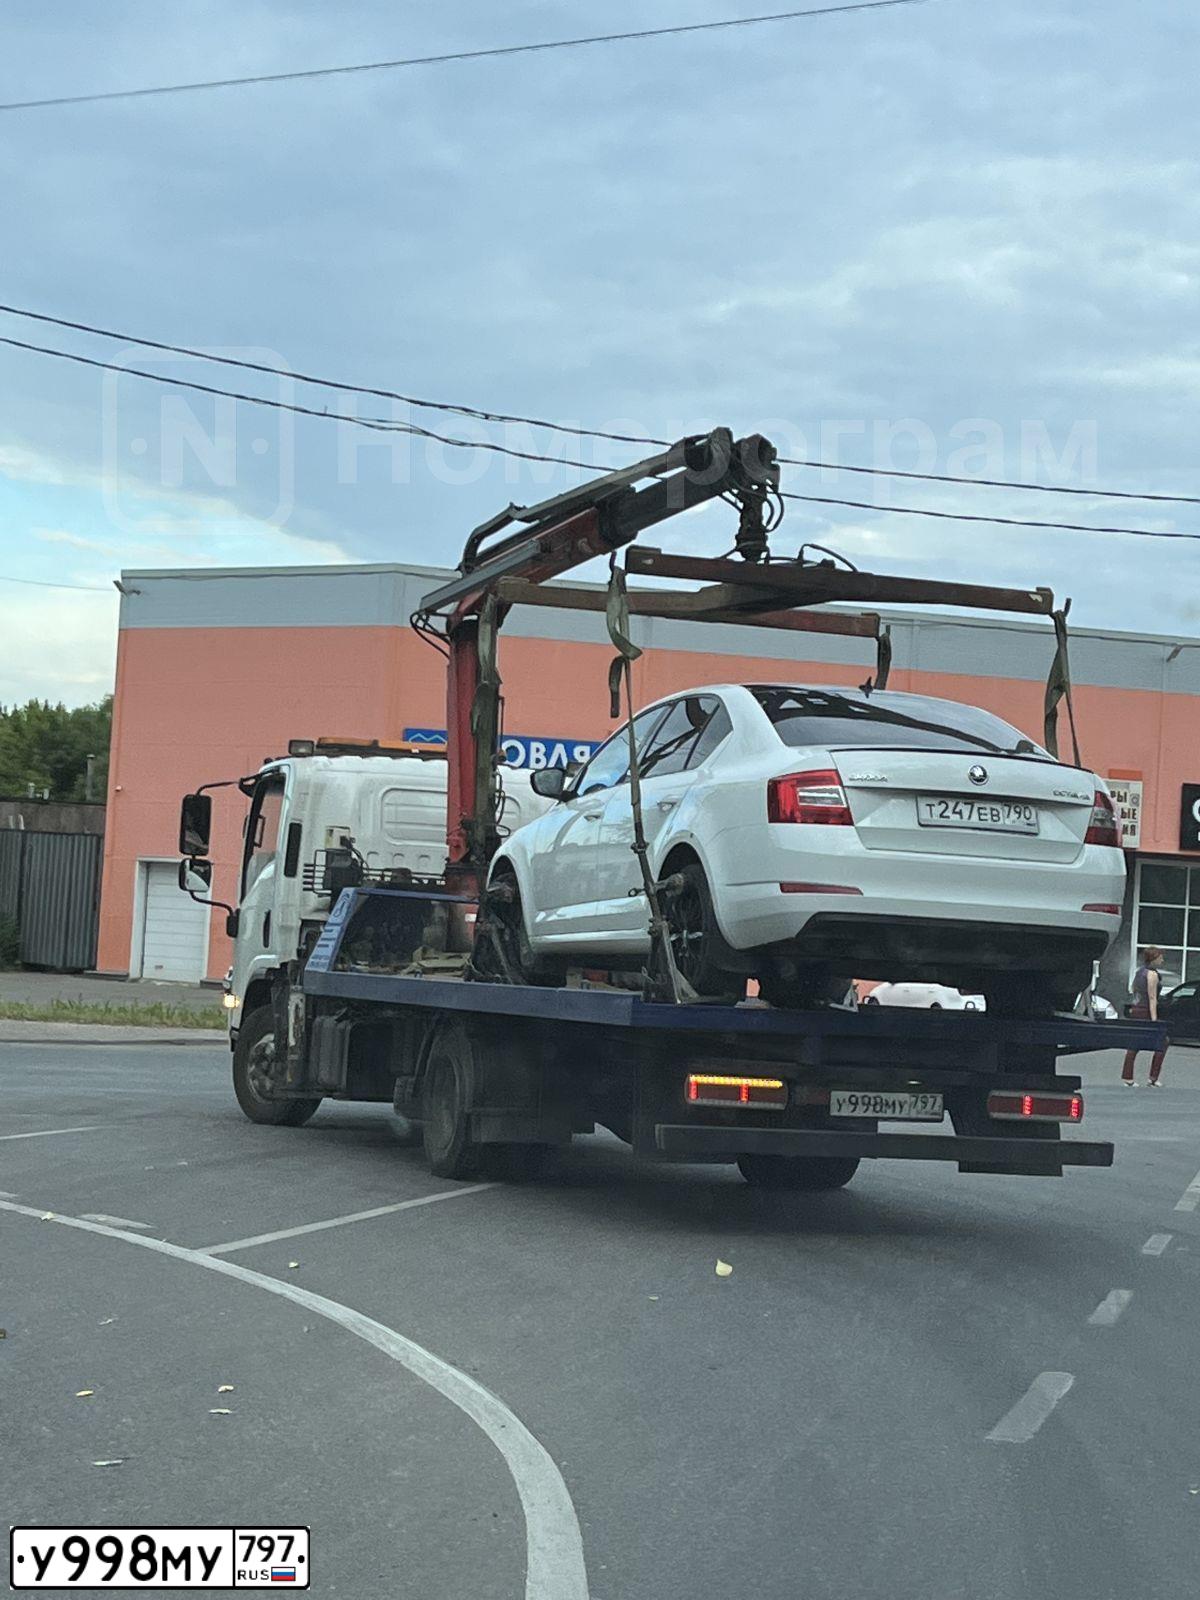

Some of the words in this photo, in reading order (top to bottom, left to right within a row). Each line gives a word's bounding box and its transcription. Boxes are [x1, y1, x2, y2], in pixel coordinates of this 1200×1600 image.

[501, 739, 590, 769] ОВЛЯ
[925, 800, 1001, 823] Т247ЕВ
[1003, 803, 1032, 821] 790
[836, 1094, 907, 1114] У998МУ
[911, 1095, 937, 1111] 797
